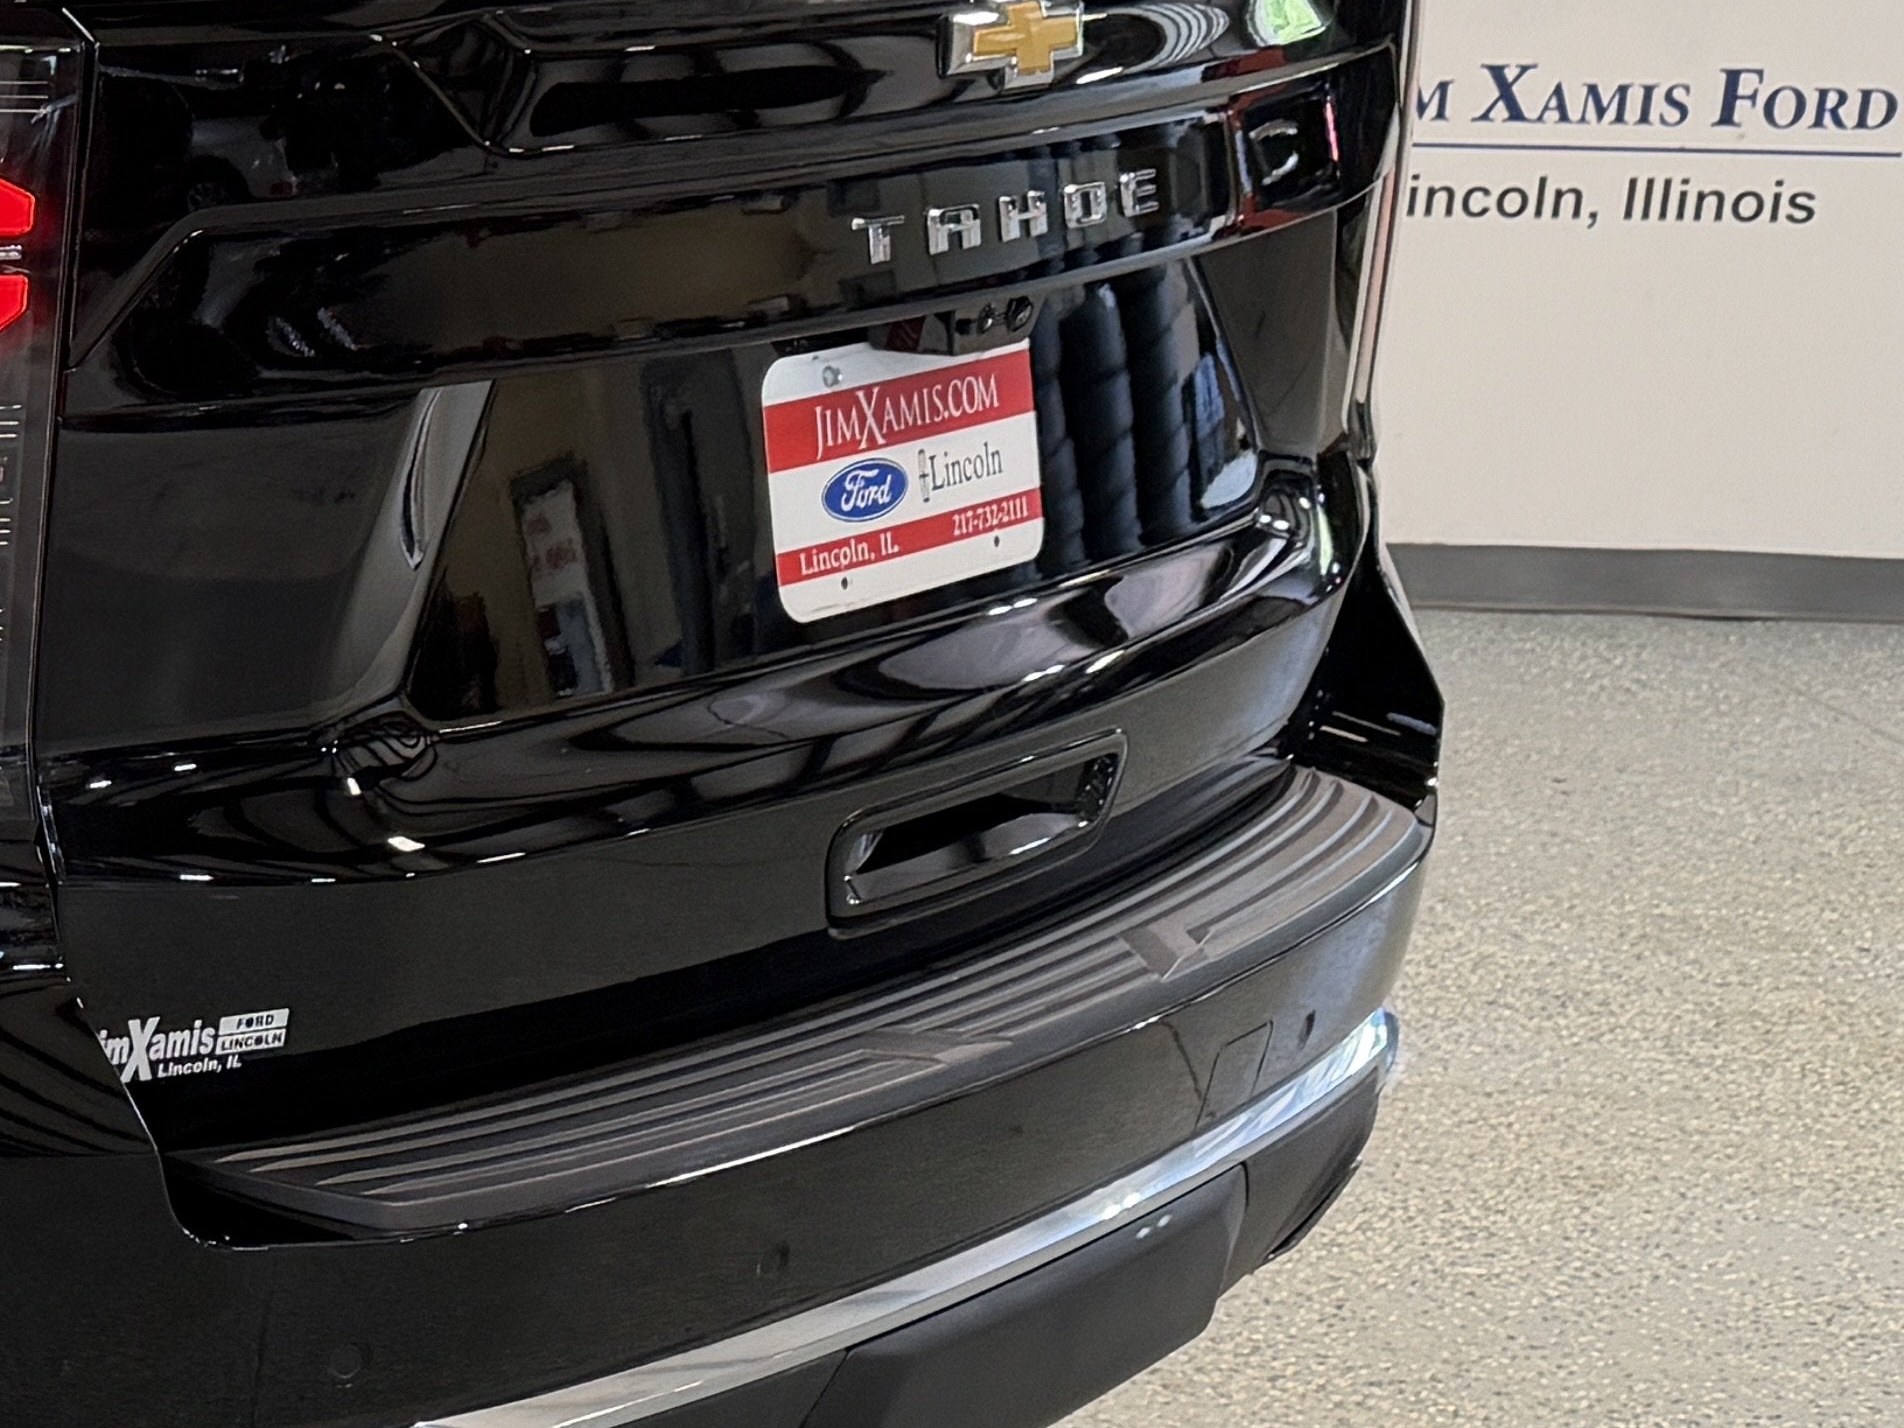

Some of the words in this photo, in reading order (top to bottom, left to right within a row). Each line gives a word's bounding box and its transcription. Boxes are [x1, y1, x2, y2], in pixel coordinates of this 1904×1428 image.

[1471, 63, 1691, 126] XAMIS
[1711, 67, 1899, 130] FORD
[851, 168, 1160, 265] TAHOE
[1406, 174, 1599, 229] incoln,
[1623, 176, 1817, 224] Illinois
[815, 374, 999, 460] JIMXAMIS.COM
[928, 442, 1003, 491] Lincoln
[841, 468, 893, 512] Ford
[952, 496, 1029, 536] 217-732-2111
[799, 538, 875, 576] Lincoln,
[220, 1033, 284, 1052] LINCOLN
[236, 1013, 275, 1029] FORD
[96, 1017, 216, 1083] imXamis
[157, 1056, 222, 1078] Lincoln,
[225, 1053, 242, 1070] IL
